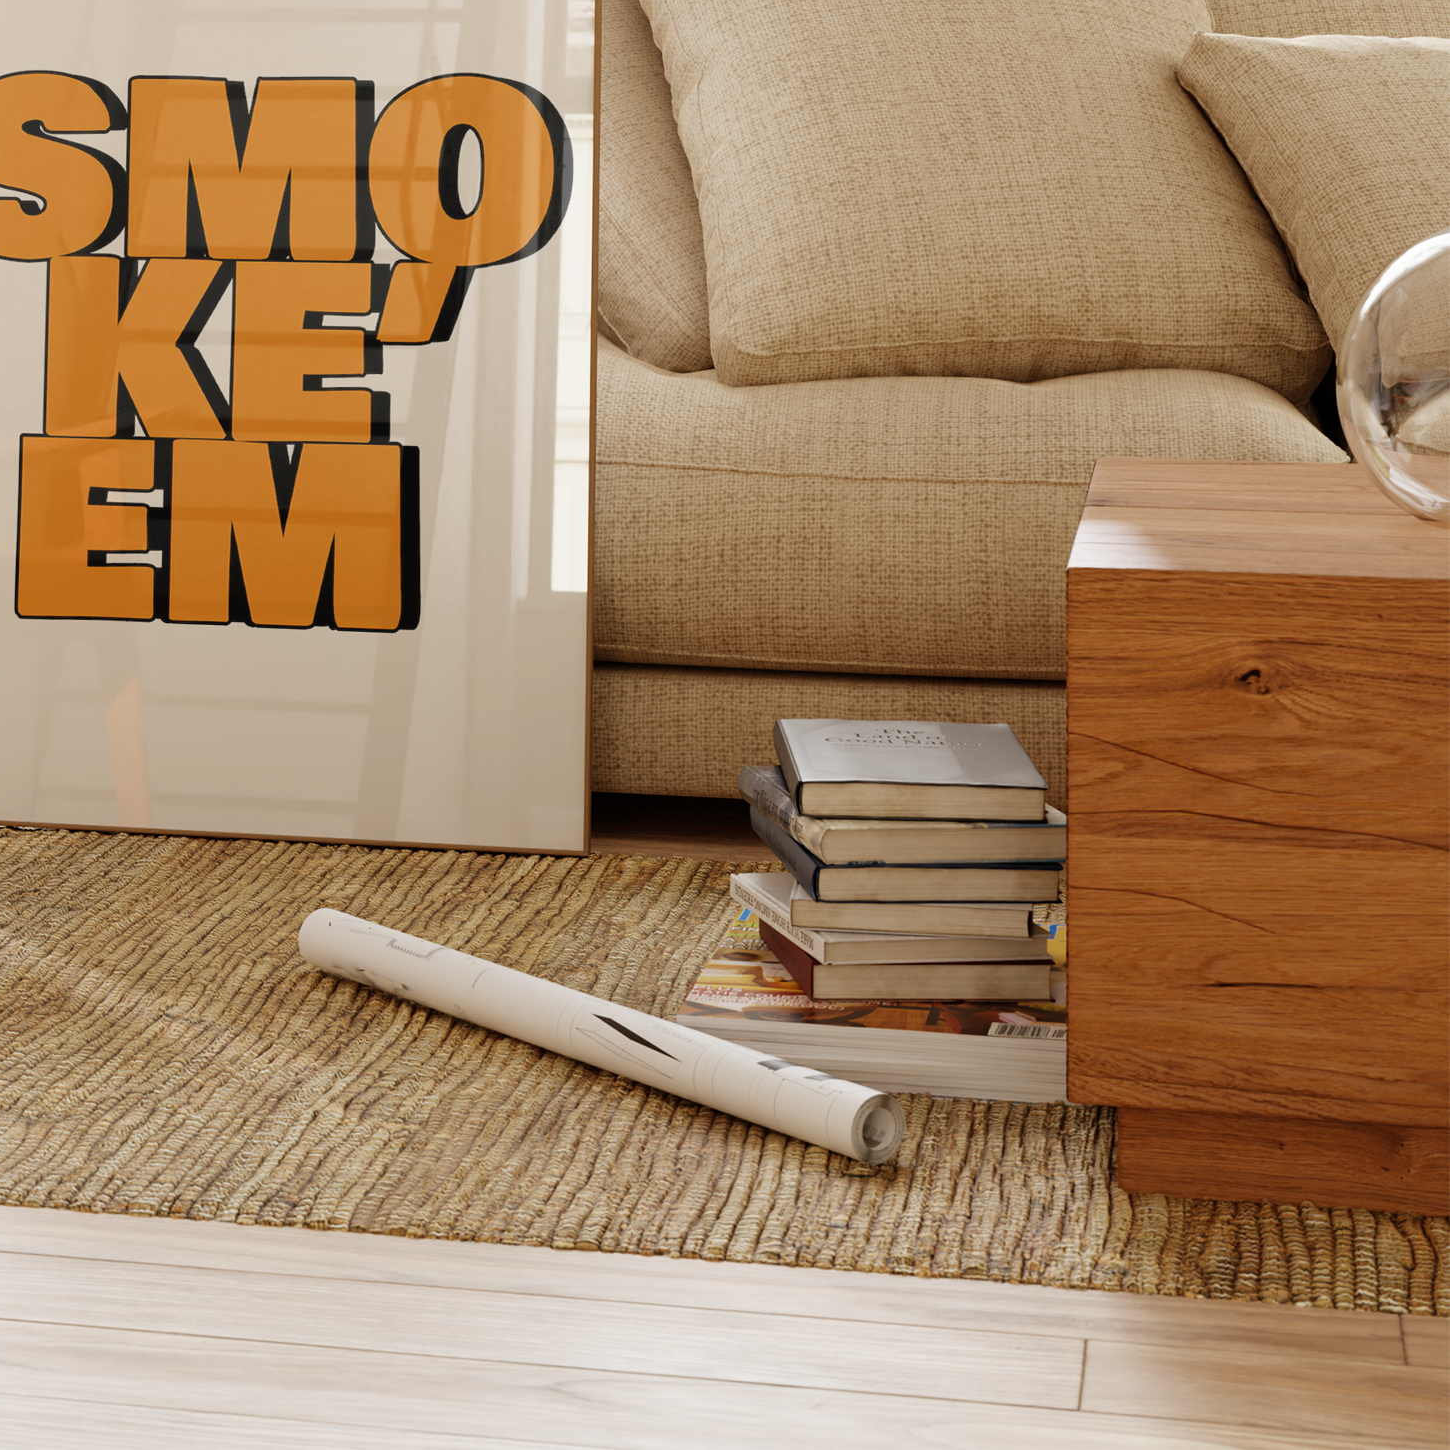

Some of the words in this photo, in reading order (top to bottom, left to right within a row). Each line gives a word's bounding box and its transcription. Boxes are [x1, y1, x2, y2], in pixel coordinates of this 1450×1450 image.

[14, 433, 421, 633] EM
[734, 884, 754, 907] FRIENDS
[754, 897, 771, 918] AMONG
[772, 910, 786, 930] HOME
[800, 930, 814, 950] MAKE
